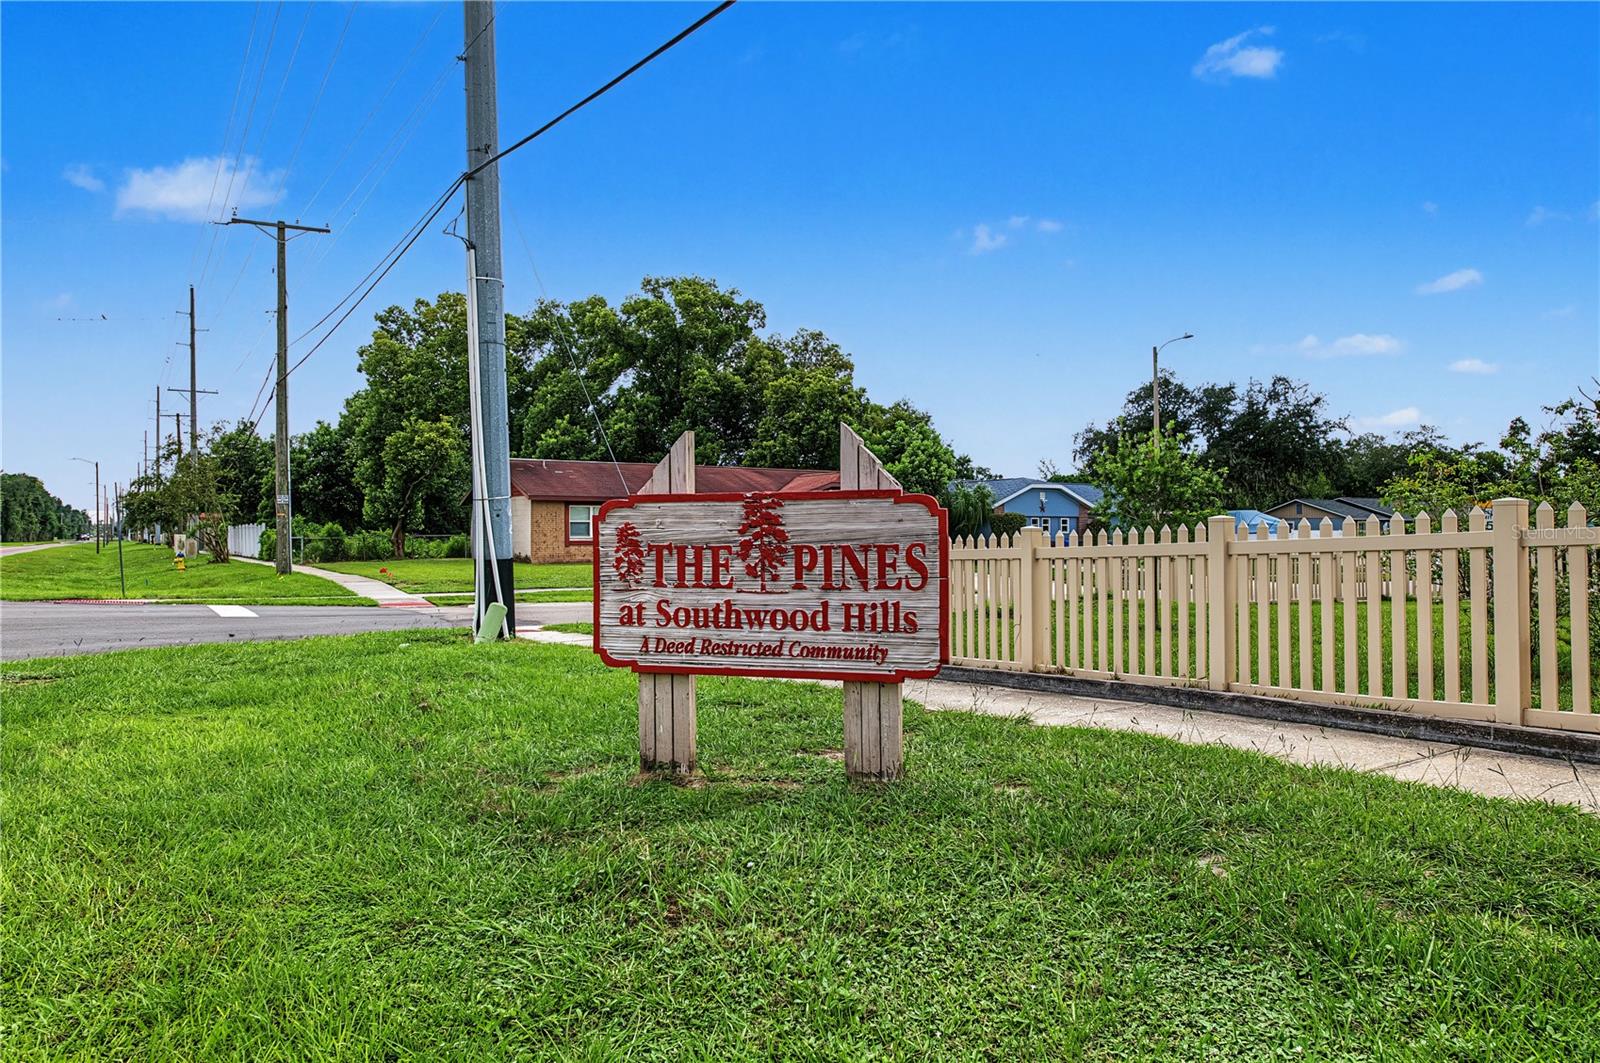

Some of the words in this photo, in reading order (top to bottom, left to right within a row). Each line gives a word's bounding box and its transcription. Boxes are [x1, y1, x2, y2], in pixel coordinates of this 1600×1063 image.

[648, 542, 735, 589] THE
[792, 542, 930, 591] PINES
[619, 603, 646, 626] at
[655, 599, 830, 632] Southwood
[842, 601, 919, 634] Hills
[639, 638, 650, 653] A
[654, 638, 696, 655] Deed
[700, 639, 784, 658] Restricted
[790, 641, 889, 665] Community
